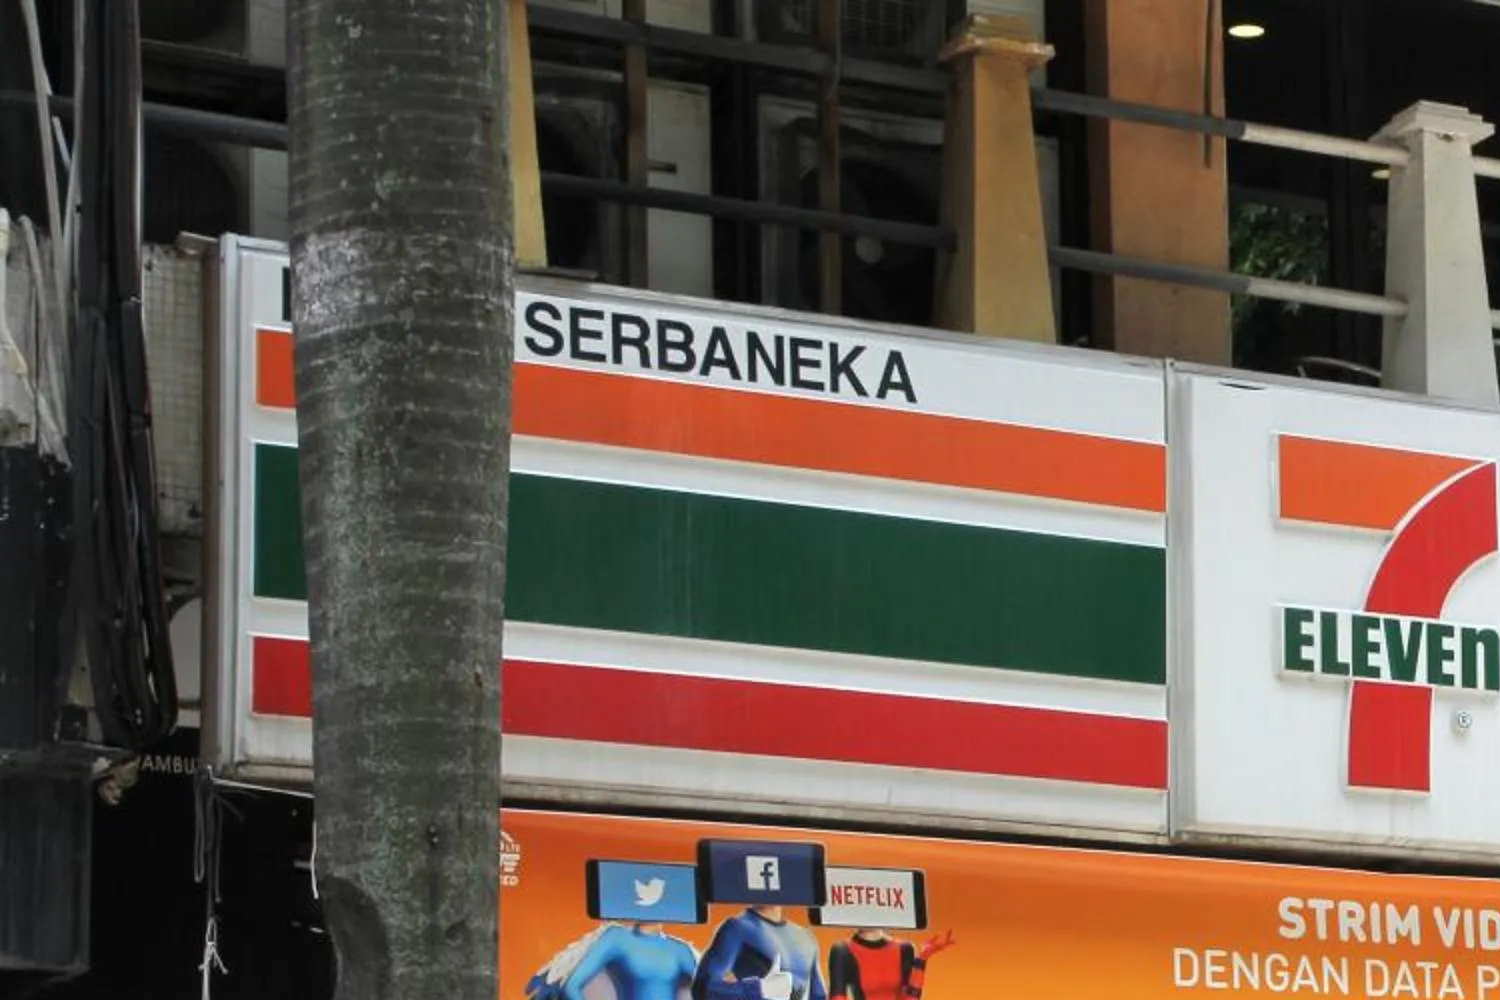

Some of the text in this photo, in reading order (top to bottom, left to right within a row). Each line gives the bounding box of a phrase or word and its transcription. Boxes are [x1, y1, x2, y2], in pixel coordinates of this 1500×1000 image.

[525, 300, 917, 403] SERBANEKA
[1279, 433, 1499, 793] 7
[134, 753, 201, 774] AMBU
[830, 885, 905, 910] NETFLIX
[1278, 896, 1422, 946] STRIM
[1173, 947, 1350, 996] DENGAN
[1364, 959, 1465, 1000] DATA
